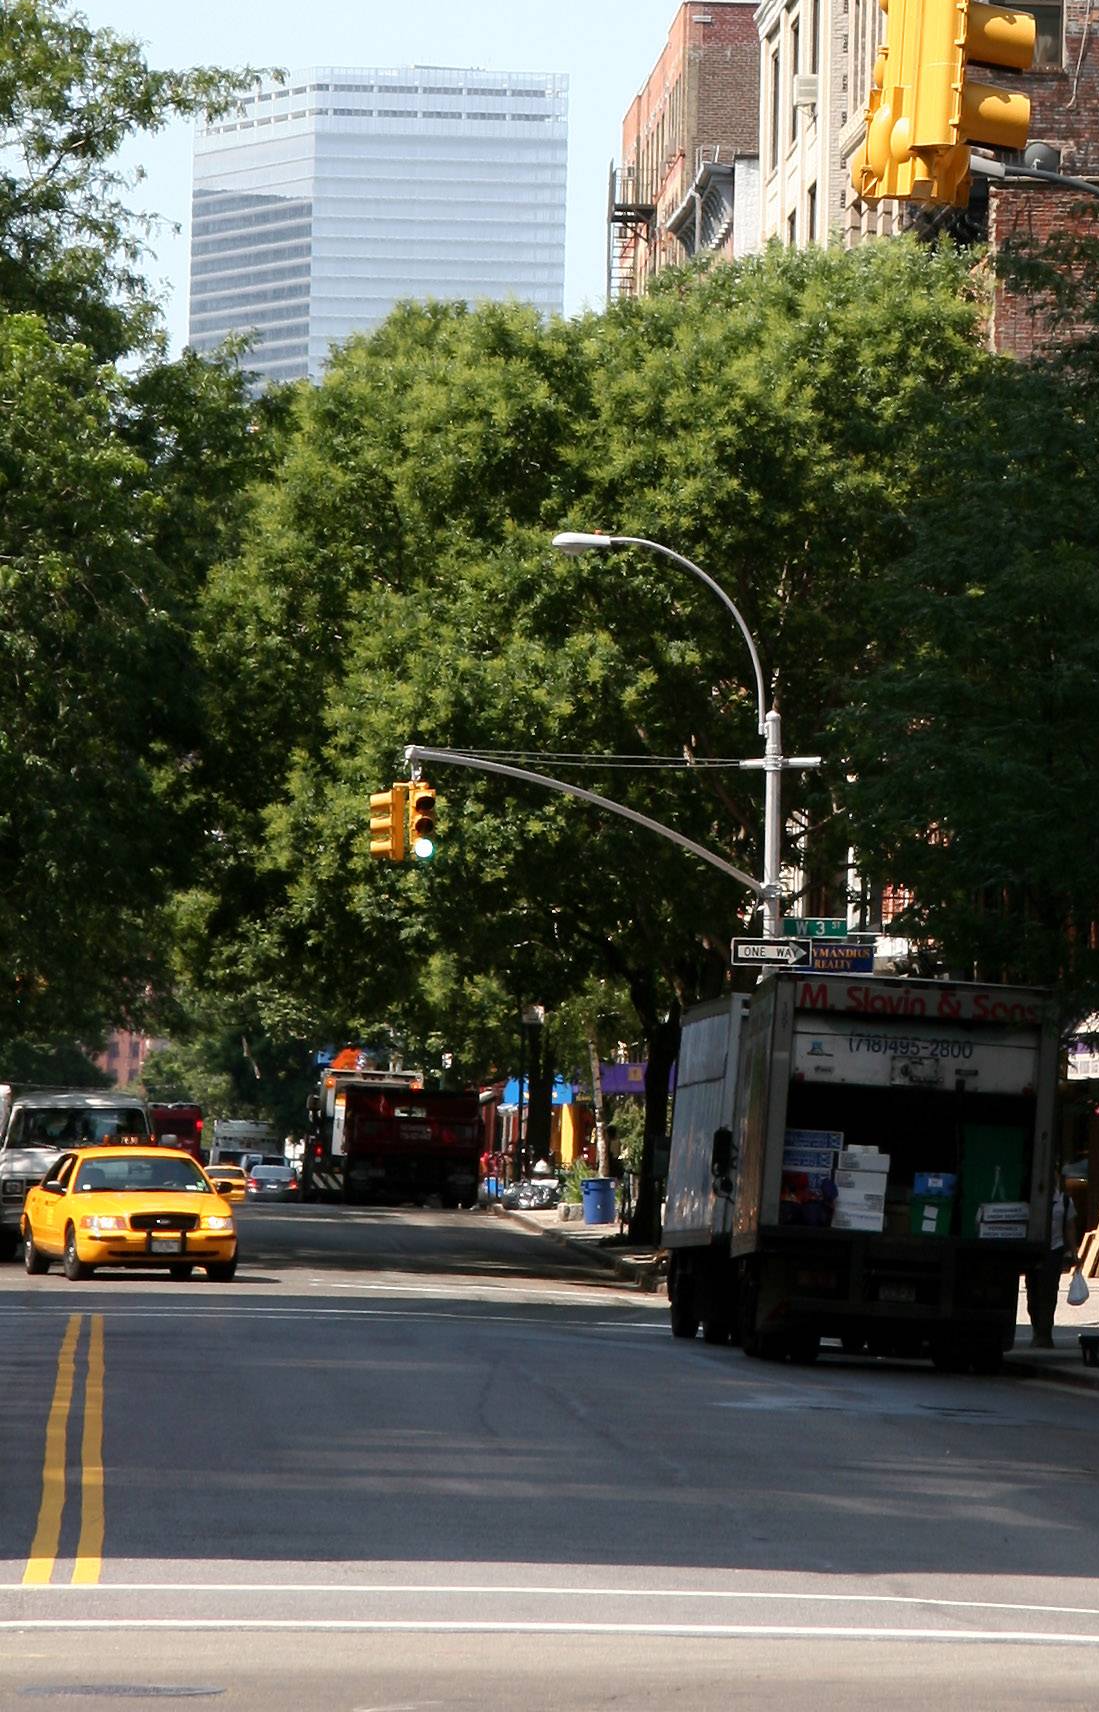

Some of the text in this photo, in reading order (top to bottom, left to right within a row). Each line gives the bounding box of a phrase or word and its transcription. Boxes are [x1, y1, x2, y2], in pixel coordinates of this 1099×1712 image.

[795, 922, 809, 935] W
[815, 922, 825, 935] 3
[744, 947, 799, 958] ONE WAY
[815, 959, 851, 970] REALTY
[937, 991, 961, 1019] &
[848, 1033, 973, 1059] (718)495-2800
